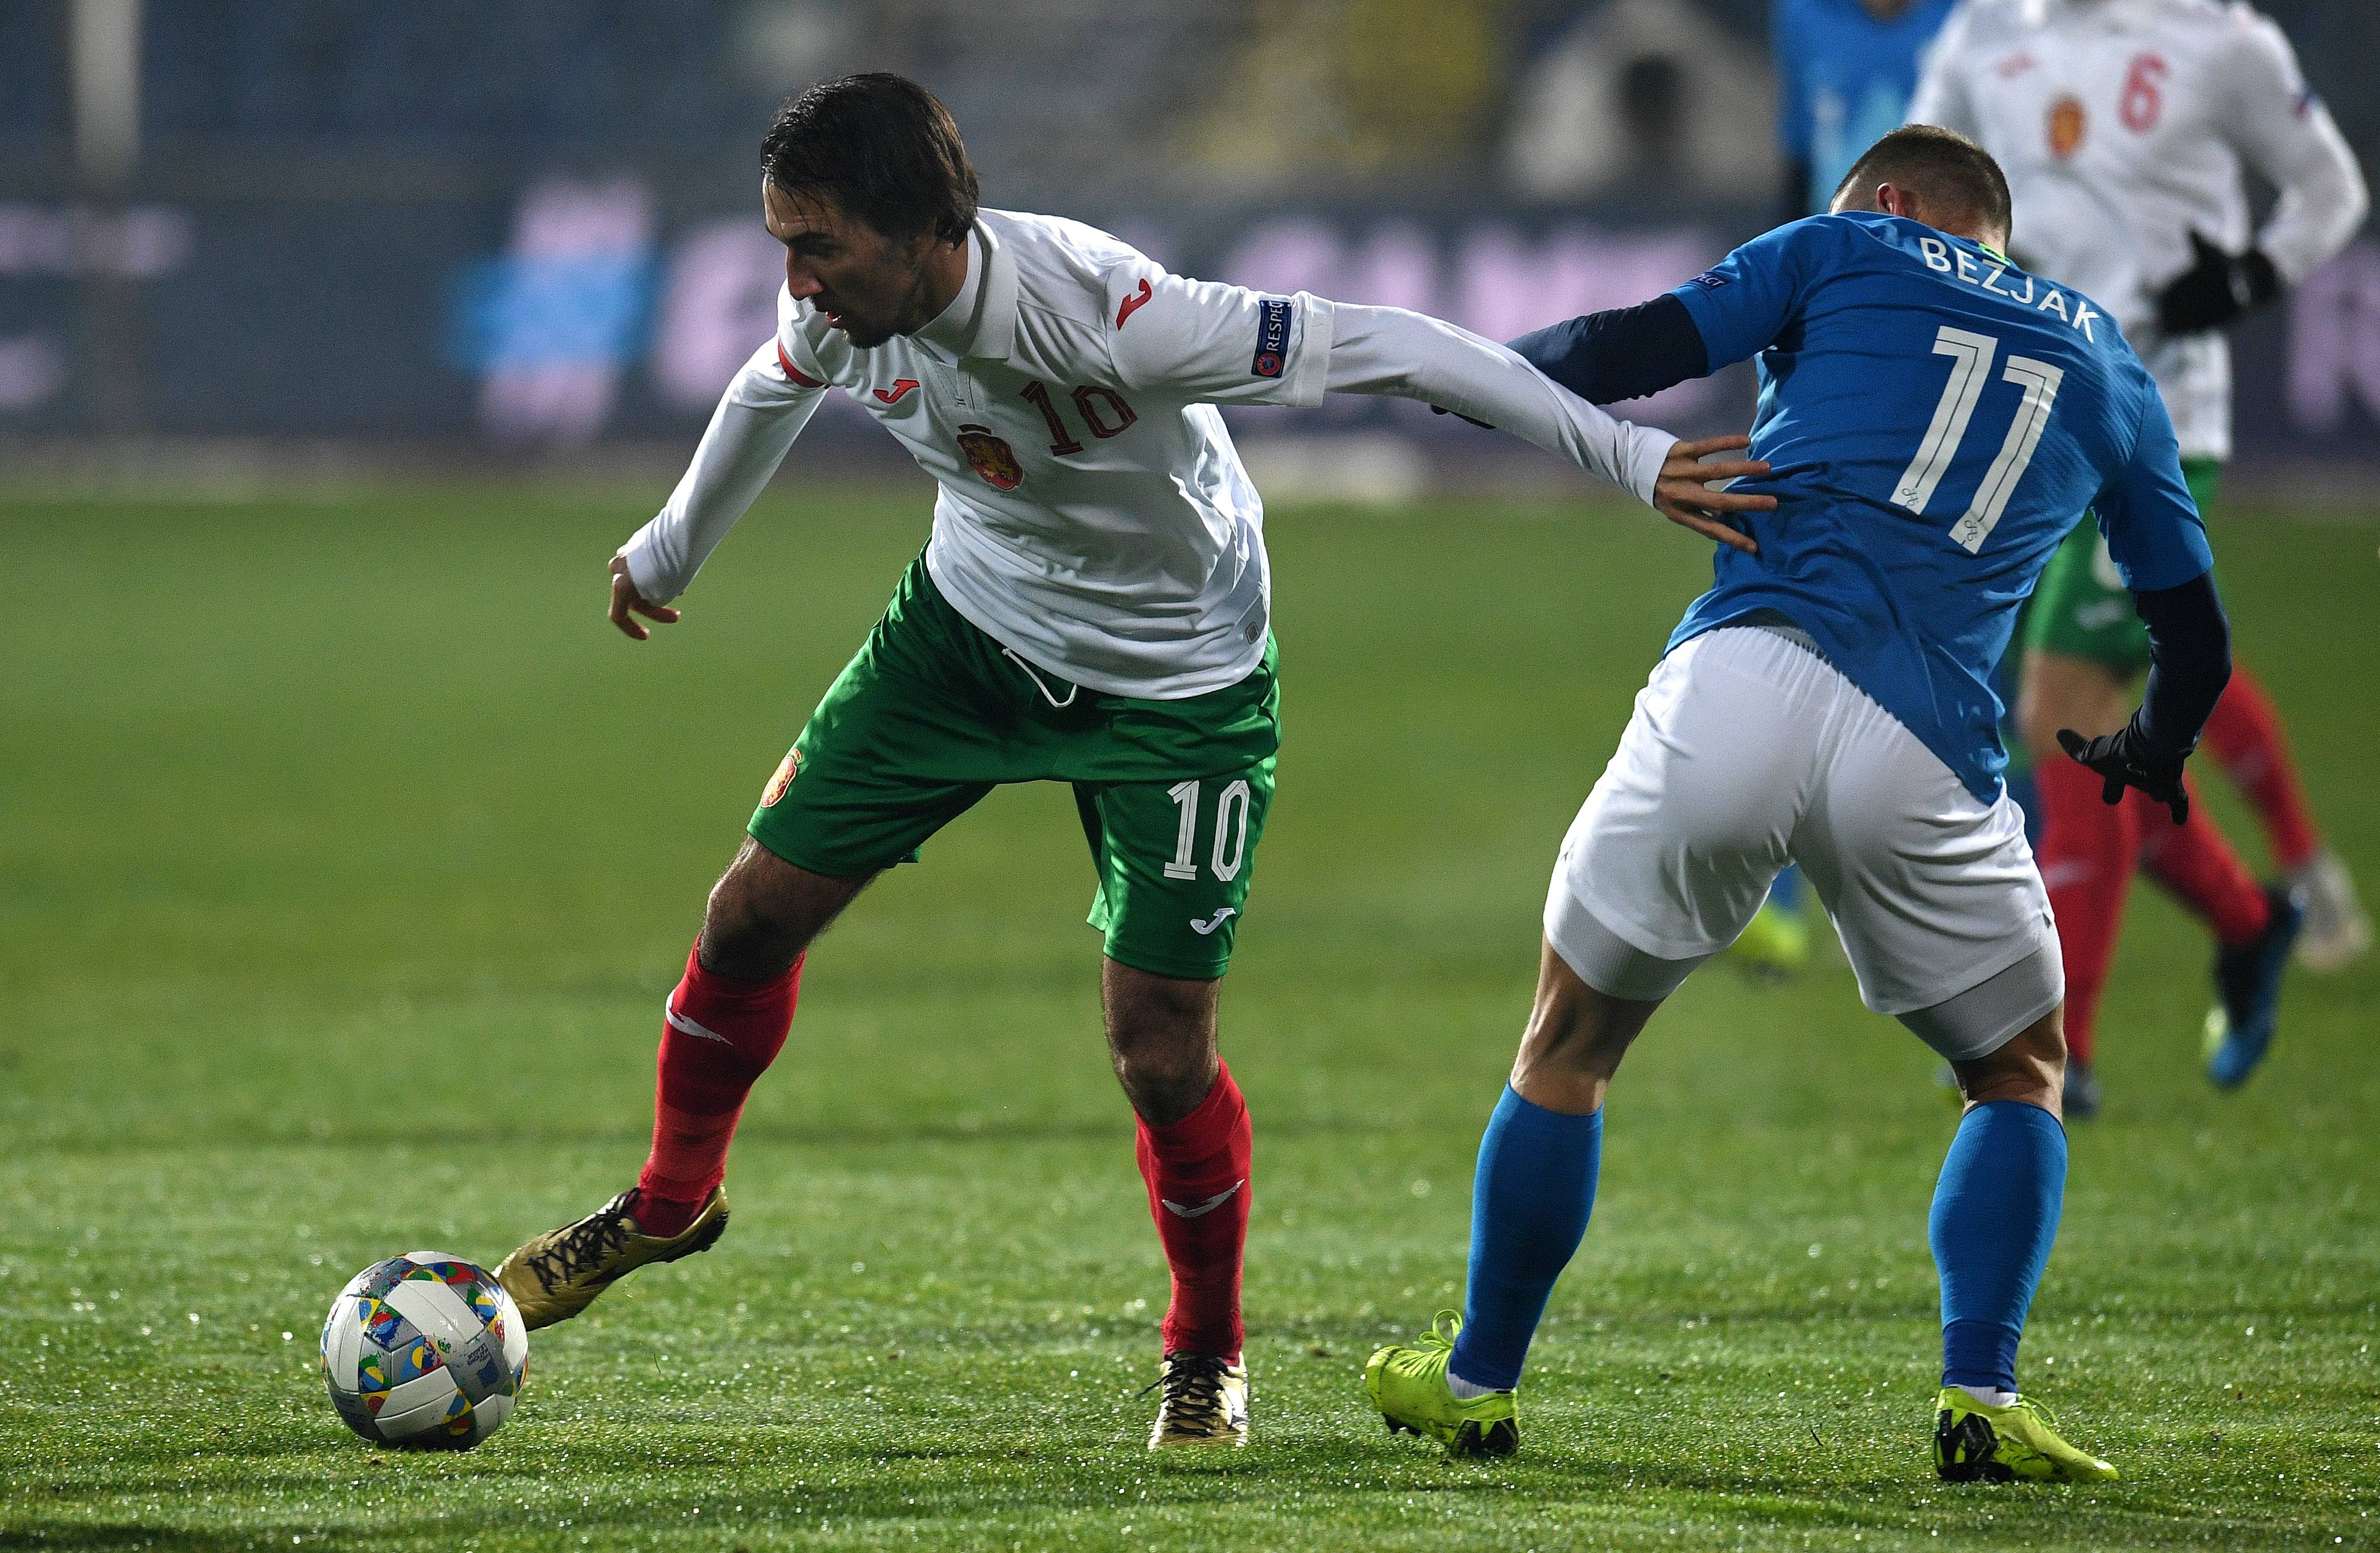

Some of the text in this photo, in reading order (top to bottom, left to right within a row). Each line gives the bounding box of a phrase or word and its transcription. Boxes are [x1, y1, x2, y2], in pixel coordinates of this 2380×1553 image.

[2120, 51, 2171, 135] 6
[1266, 300, 1284, 352] RESPEC
[1919, 237, 2100, 344] BEZJAK
[1019, 381, 1138, 457] 10
[1888, 325, 2064, 555] 11
[1164, 780, 1250, 881] 10
